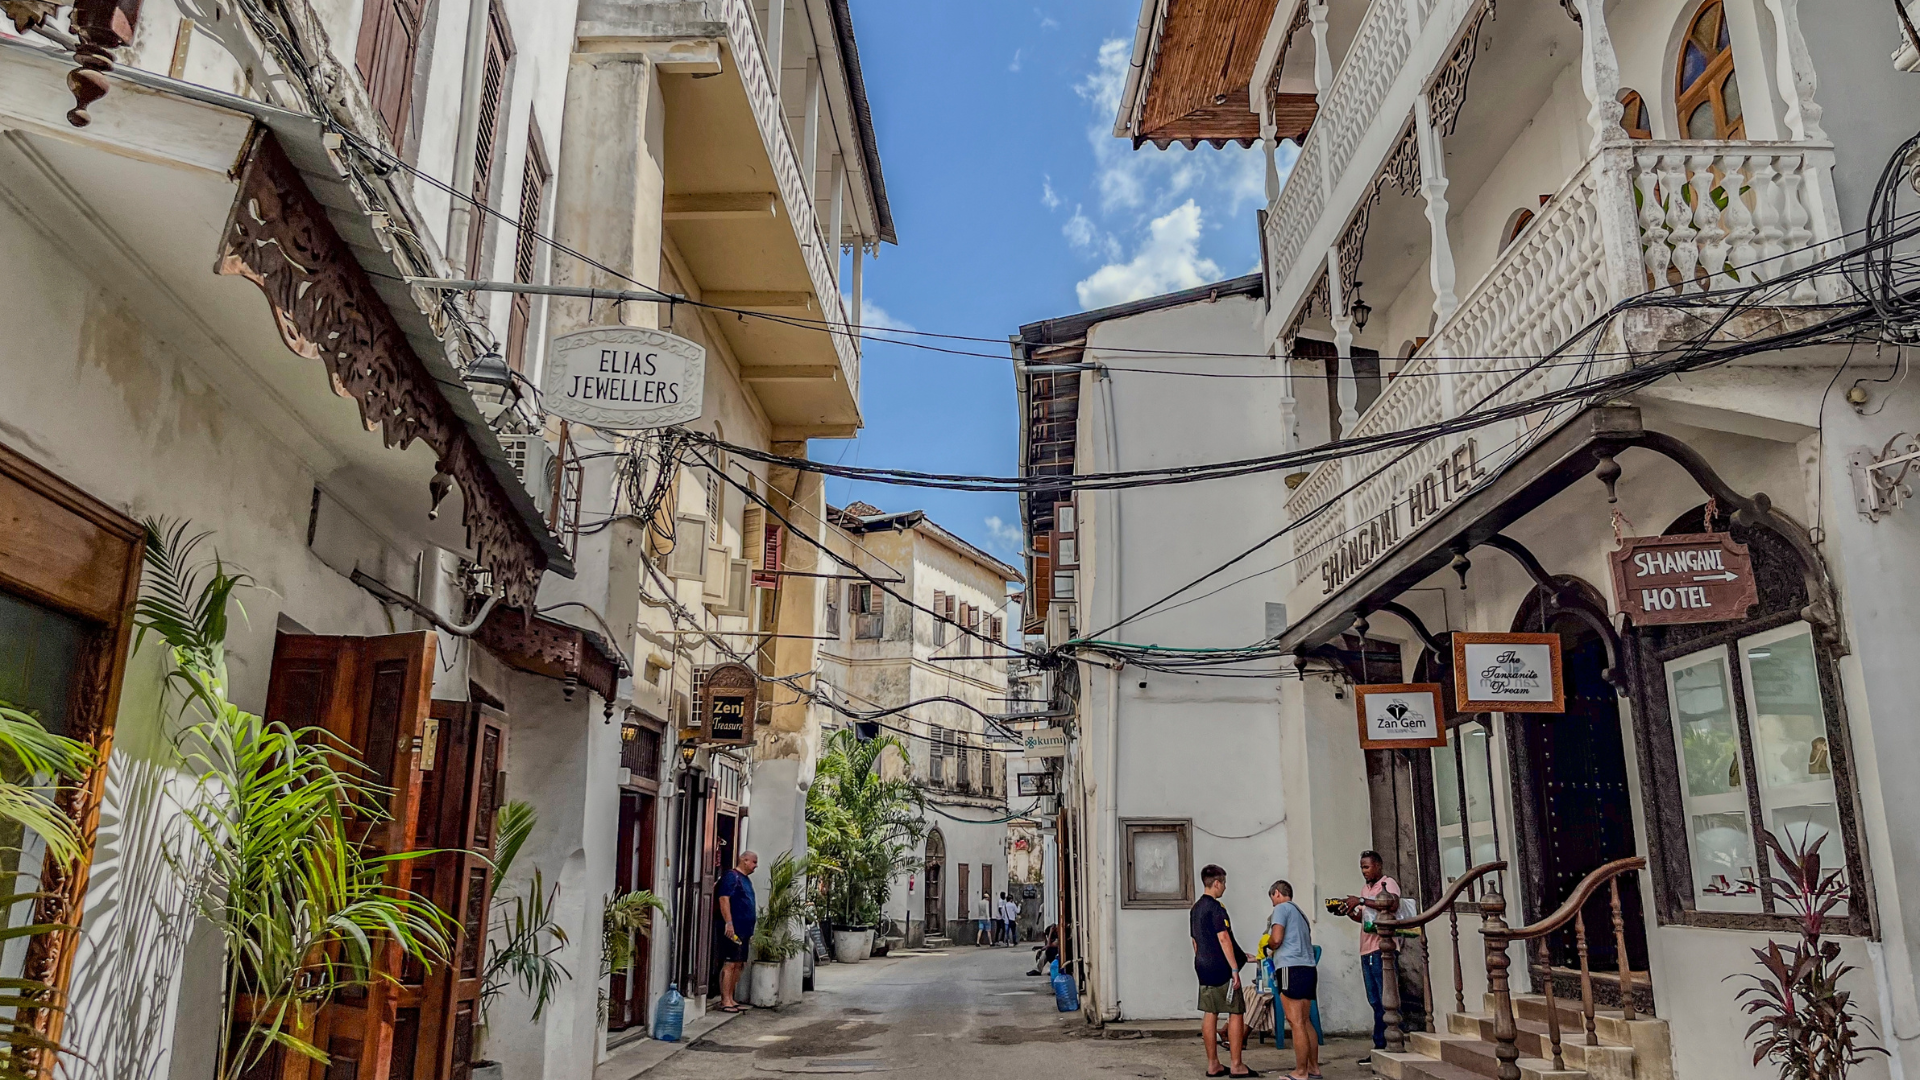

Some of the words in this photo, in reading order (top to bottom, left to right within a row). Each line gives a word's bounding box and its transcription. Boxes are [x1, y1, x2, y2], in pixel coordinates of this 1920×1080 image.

[599, 349, 658, 376] ELIAS
[567, 375, 679, 404] JEWELLERS
[1321, 503, 1401, 595] SHANGANI
[1408, 437, 1486, 527] HOTEL
[1634, 549, 1725, 577] SHANGANI
[1642, 586, 1712, 612] HOTEL
[1496, 650, 1521, 664] The
[1480, 665, 1538, 679] Tanzanite
[1489, 680, 1530, 695] Dream
[713, 701, 745, 718] Zenj
[712, 717, 743, 731] Treasure
[1377, 718, 1398, 729] Zan
[1400, 717, 1427, 728] Gem
[1037, 734, 1063, 746] kumi
